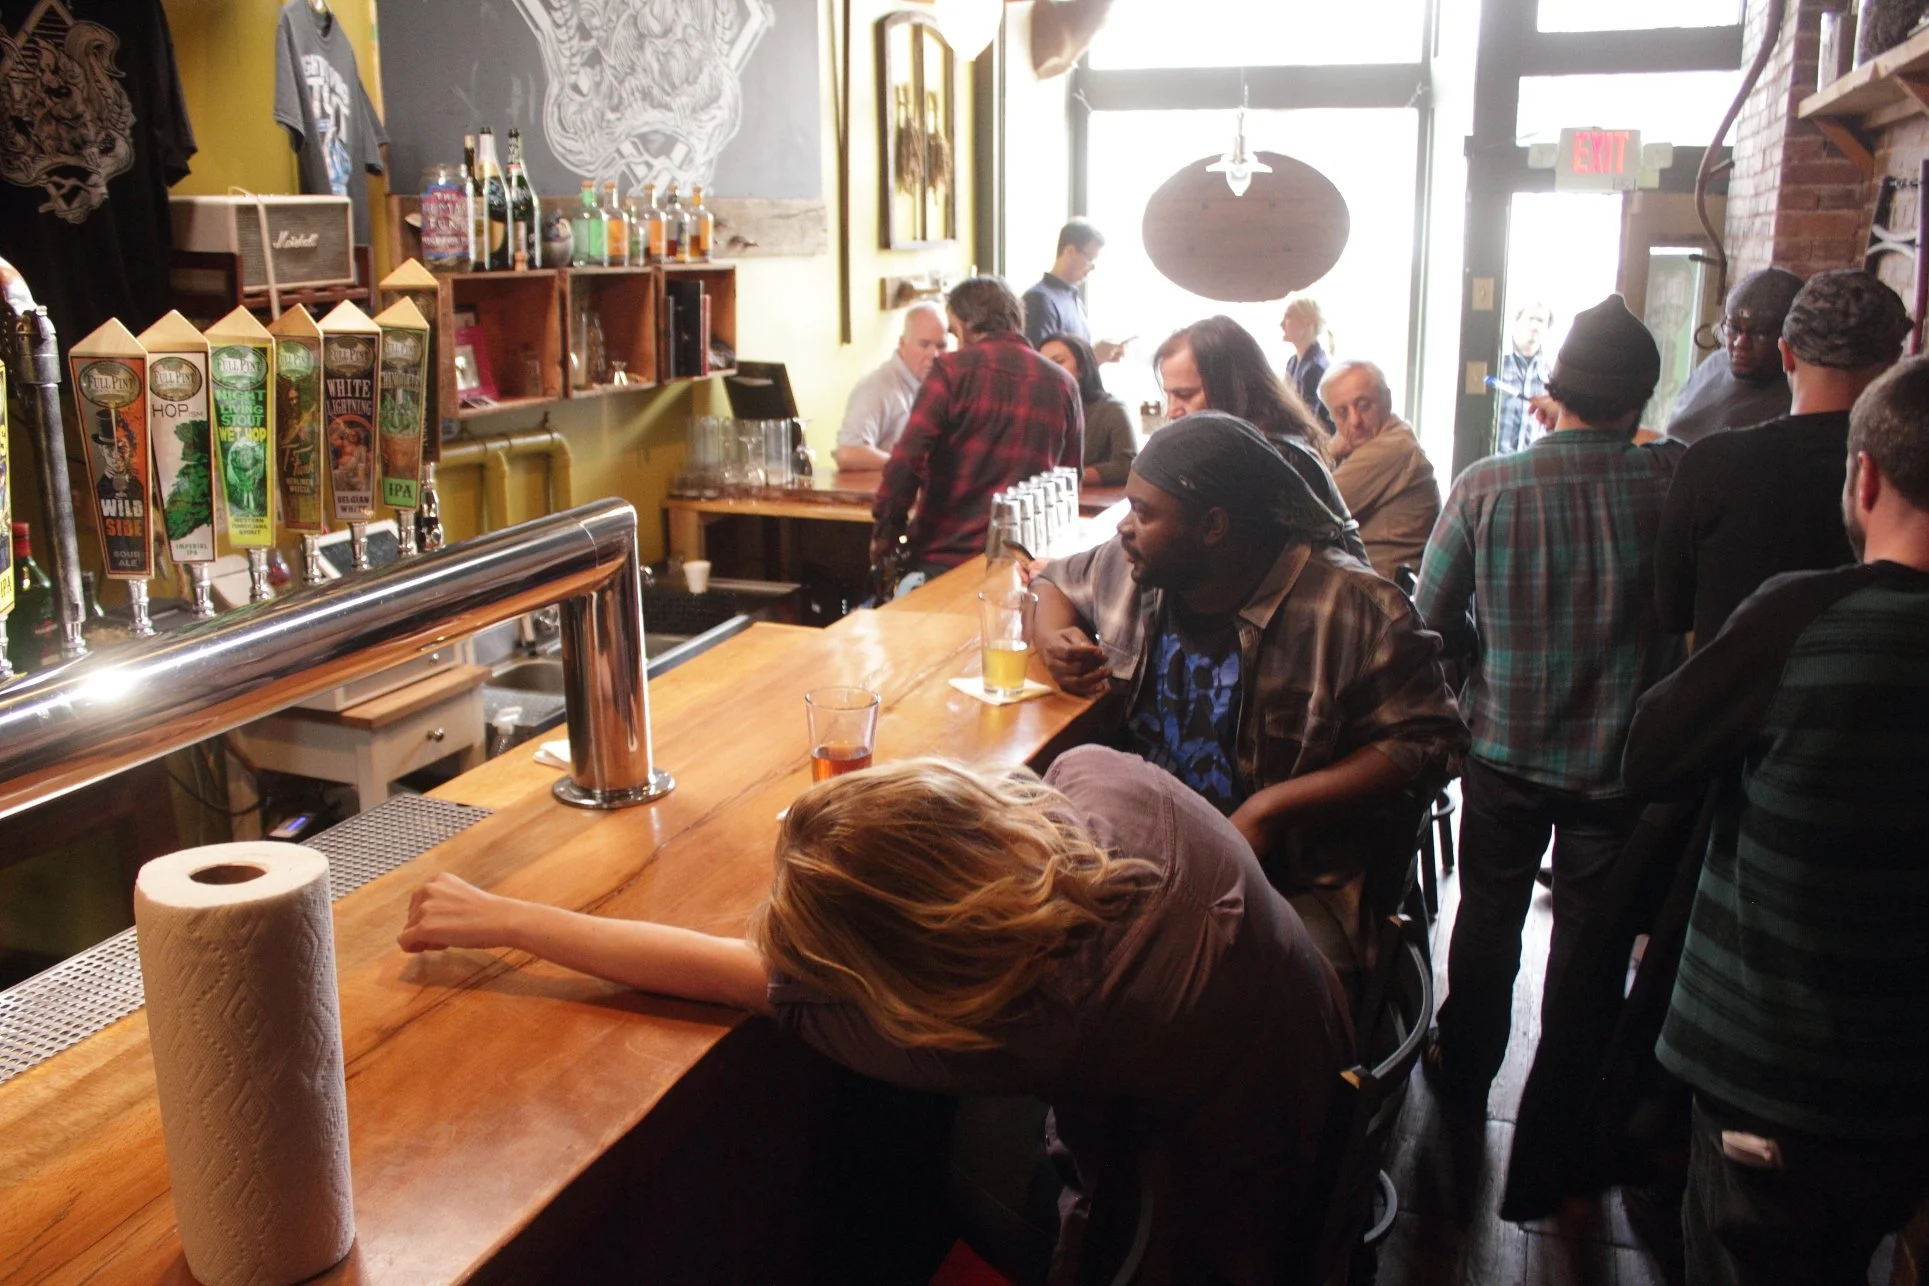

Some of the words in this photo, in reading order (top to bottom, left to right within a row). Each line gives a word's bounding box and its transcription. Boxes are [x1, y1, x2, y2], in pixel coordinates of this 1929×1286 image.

[1573, 131, 1629, 174] EXIT
[217, 360, 239, 371] FULL
[240, 360, 263, 371] PINT
[88, 376, 111, 388] FULL
[112, 376, 135, 389] PINT
[154, 371, 174, 383] FULL
[326, 379, 371, 398] WHITE
[215, 390, 265, 401] NIGHT
[221, 405, 264, 415] LIVING
[326, 400, 372, 416] LIGHTNING
[221, 415, 263, 427] STOUT
[218, 427, 242, 442] WET
[244, 427, 267, 442] HOP
[388, 483, 413, 499] IPA
[338, 496, 369, 504] BELGIAN
[101, 499, 144, 517] WILD
[105, 519, 142, 536] SIDE
[113, 551, 141, 559] SOUR
